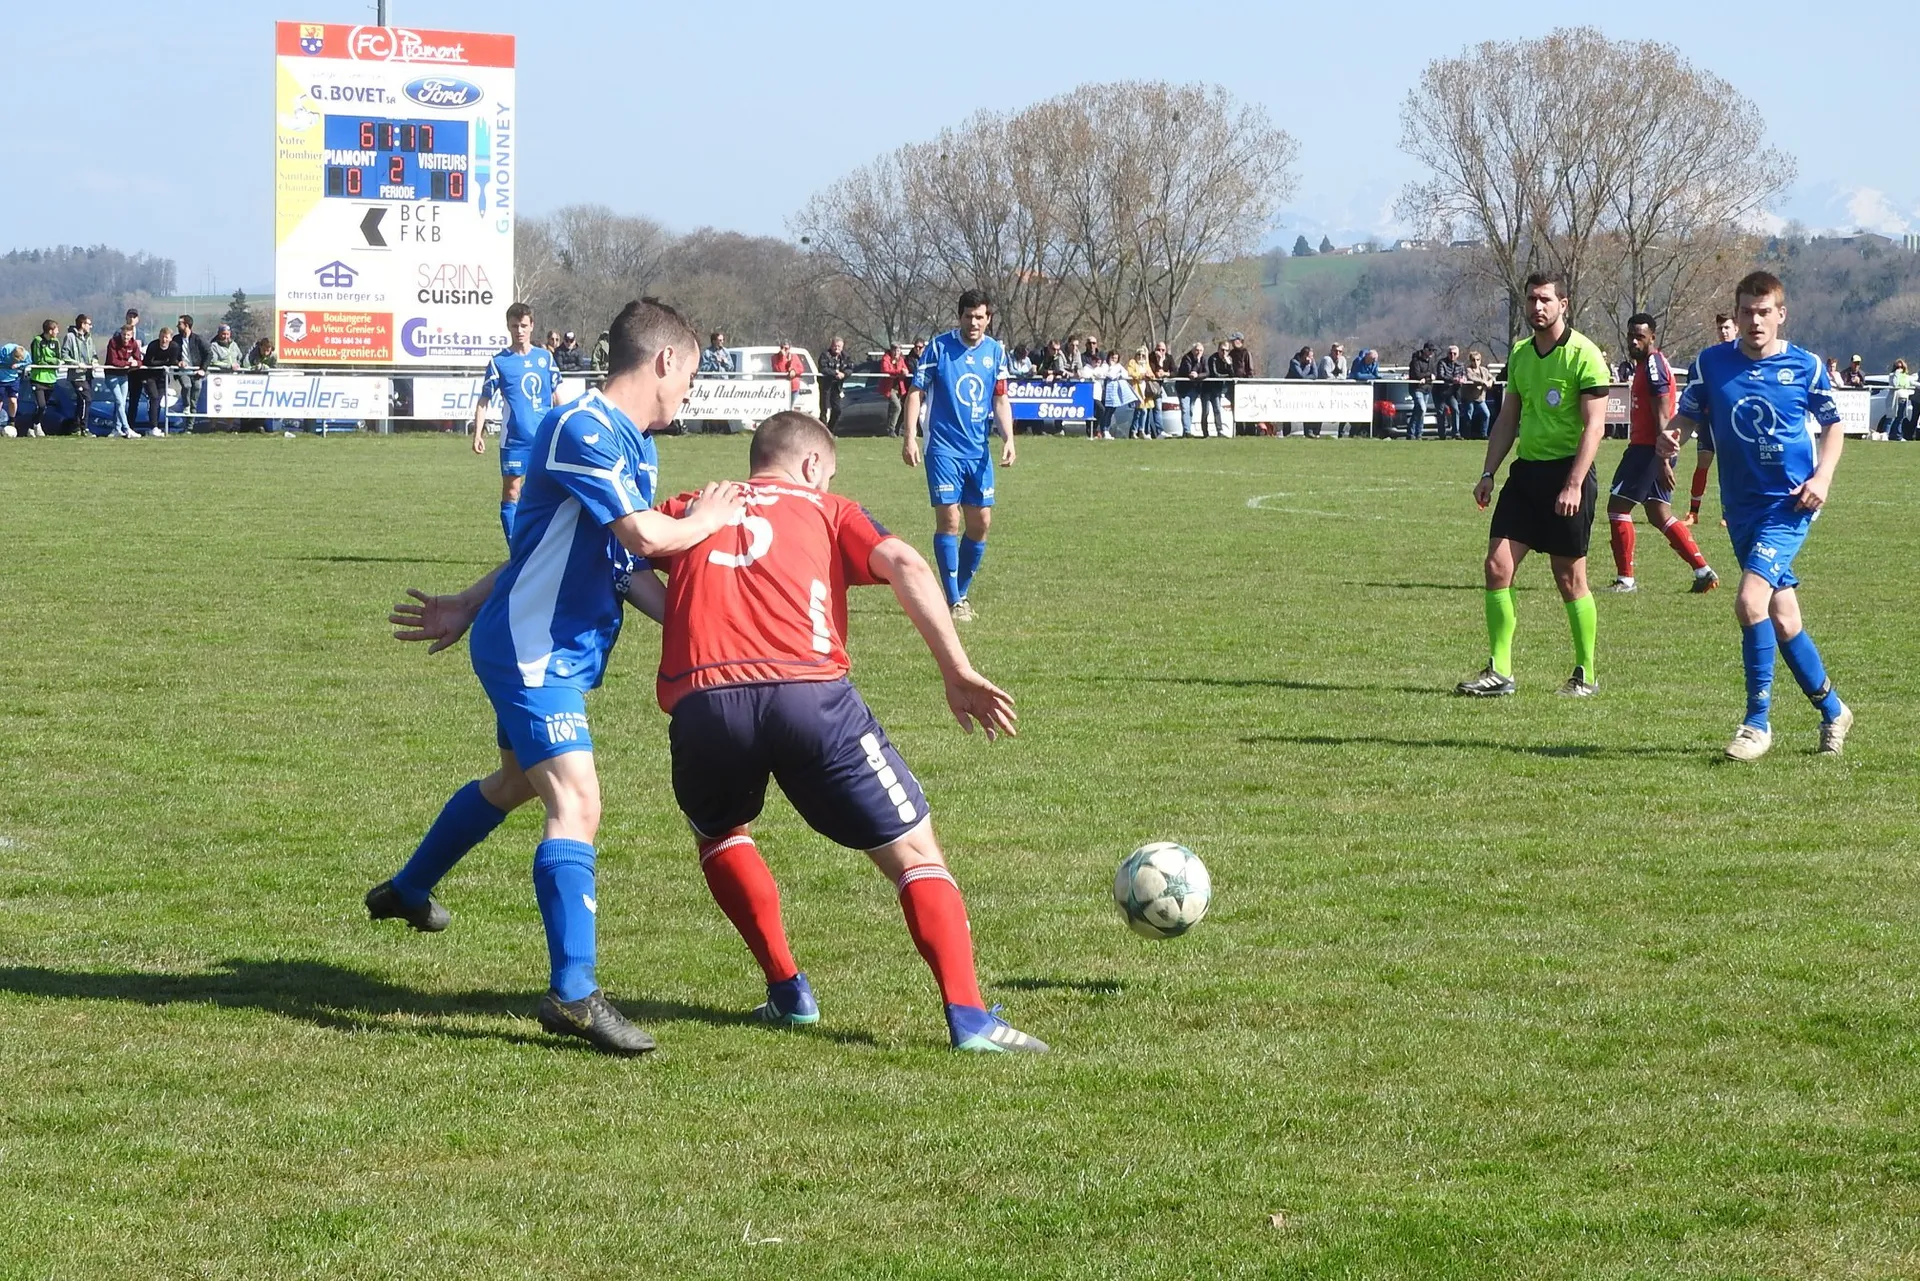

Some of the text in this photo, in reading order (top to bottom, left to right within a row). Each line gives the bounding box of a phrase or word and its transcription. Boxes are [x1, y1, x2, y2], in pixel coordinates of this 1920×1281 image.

[357, 33, 389, 56] FC
[417, 79, 467, 105] Ford
[279, 135, 306, 146] Votre
[279, 149, 323, 161] Plombier
[324, 149, 377, 167] PIAMONT
[418, 152, 467, 171] VISITEURS
[391, 157, 403, 182] 2
[348, 168, 361, 194] 0
[450, 172, 463, 198] 0
[379, 184, 415, 199] PERIODE
[417, 263, 493, 290] SARINA
[288, 291, 385, 303] christian berger sa
[417, 288, 493, 305] cuisine
[323, 312, 372, 325] Boulangerie
[310, 324, 386, 335] Au Vieux Grenier SA
[401, 317, 508, 358] Christan sa
[283, 345, 389, 361] www.vieux-grenier.ch
[233, 377, 359, 409] schwaller sa
[714, 384, 786, 400] Automobiles
[1008, 382, 1076, 398] Schenker
[1038, 403, 1085, 418] Stores
[1353, 400, 1369, 410] SA
[1759, 444, 1784, 452] RISSE
[1760, 452, 1772, 460] SA
